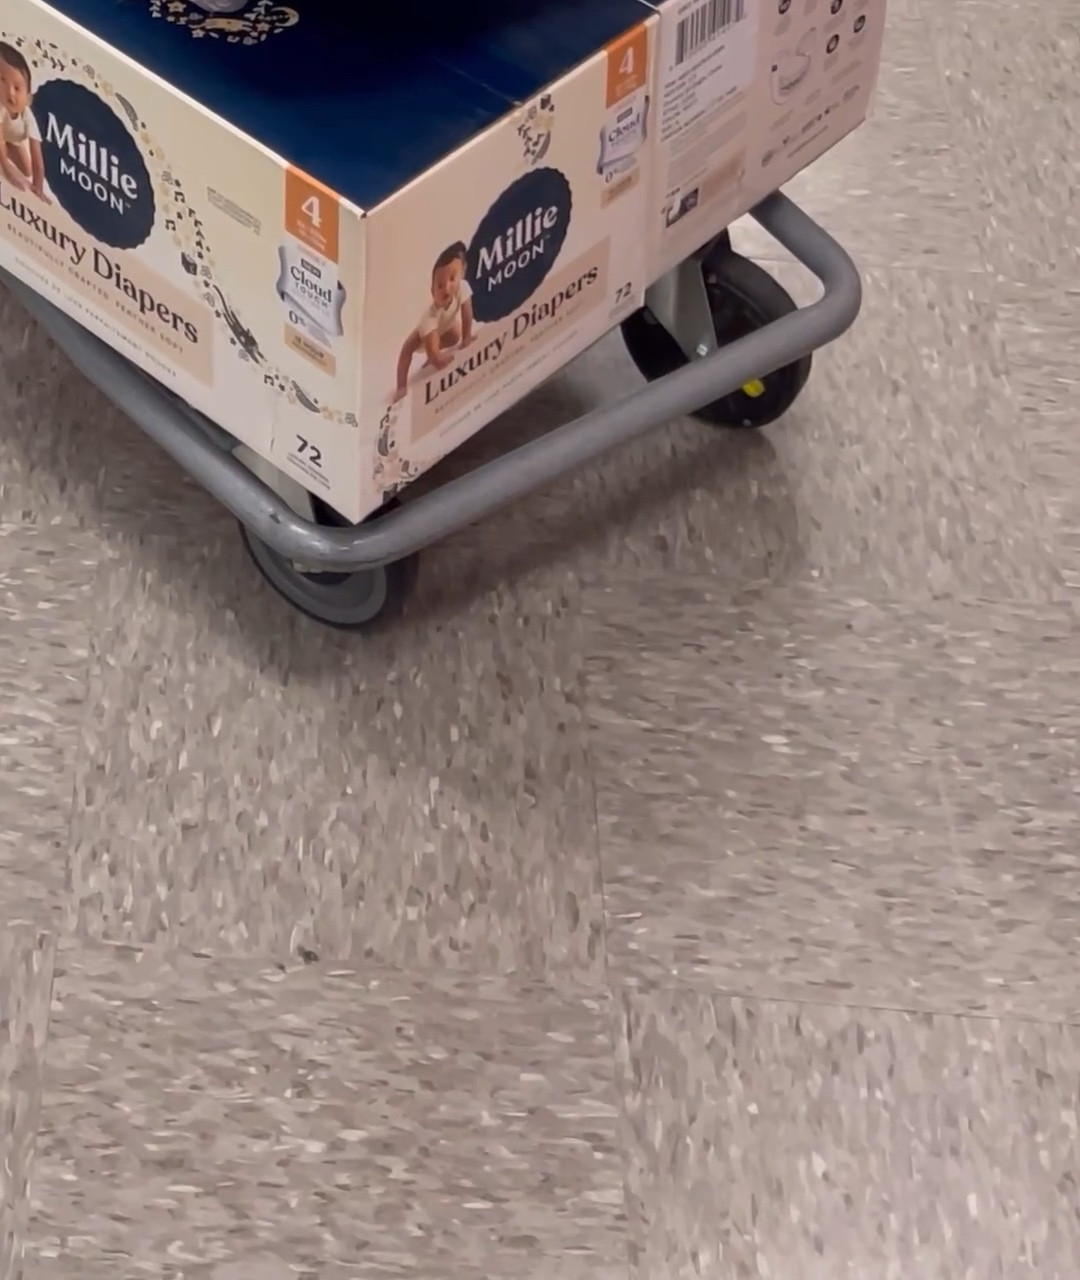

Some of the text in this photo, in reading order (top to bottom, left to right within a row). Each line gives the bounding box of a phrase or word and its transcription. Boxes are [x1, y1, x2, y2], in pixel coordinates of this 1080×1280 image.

[618, 46, 635, 74] 4
[608, 111, 641, 142] Cloud
[45, 111, 138, 200] Millie
[59, 156, 124, 216] MOON
[301, 195, 322, 228] 4
[475, 204, 559, 280] Millie
[289, 265, 333, 304] Cloud
[486, 238, 545, 293] MOON
[92, 246, 199, 344] Diapers
[294, 281, 329, 308] TOUCH
[614, 281, 633, 305] 72
[423, 328, 508, 406] Luxury
[511, 265, 599, 341] Diapers
[296, 433, 322, 469] 72
